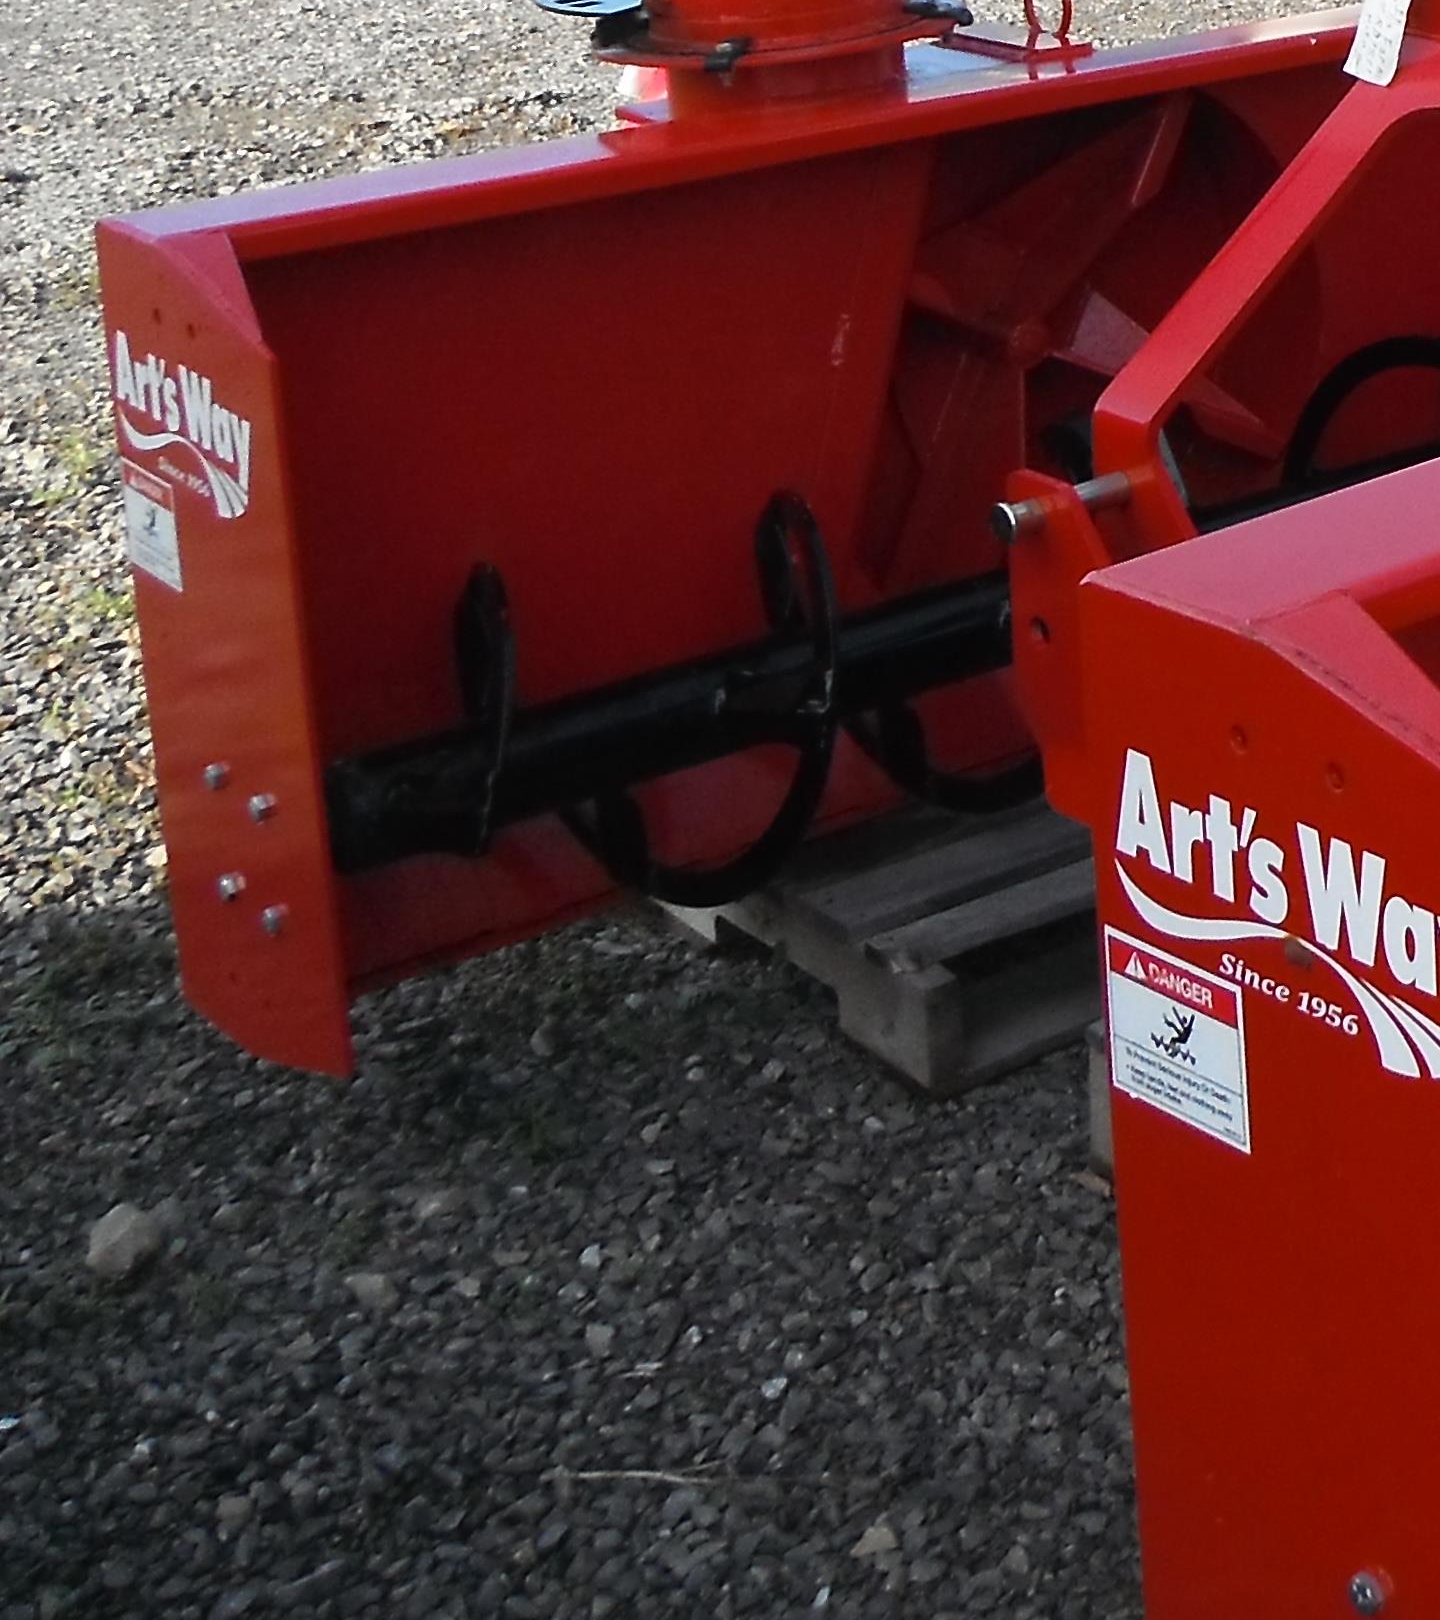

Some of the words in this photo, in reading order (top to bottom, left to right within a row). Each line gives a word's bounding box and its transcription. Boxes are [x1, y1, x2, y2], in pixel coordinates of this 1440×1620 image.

[116, 330, 180, 432] Art's
[178, 363, 251, 490] Way
[1115, 747, 1289, 924] Art's
[1147, 961, 1214, 1011] DANGER
[1218, 952, 1290, 1003] Since
[1297, 990, 1360, 1037] 1956
